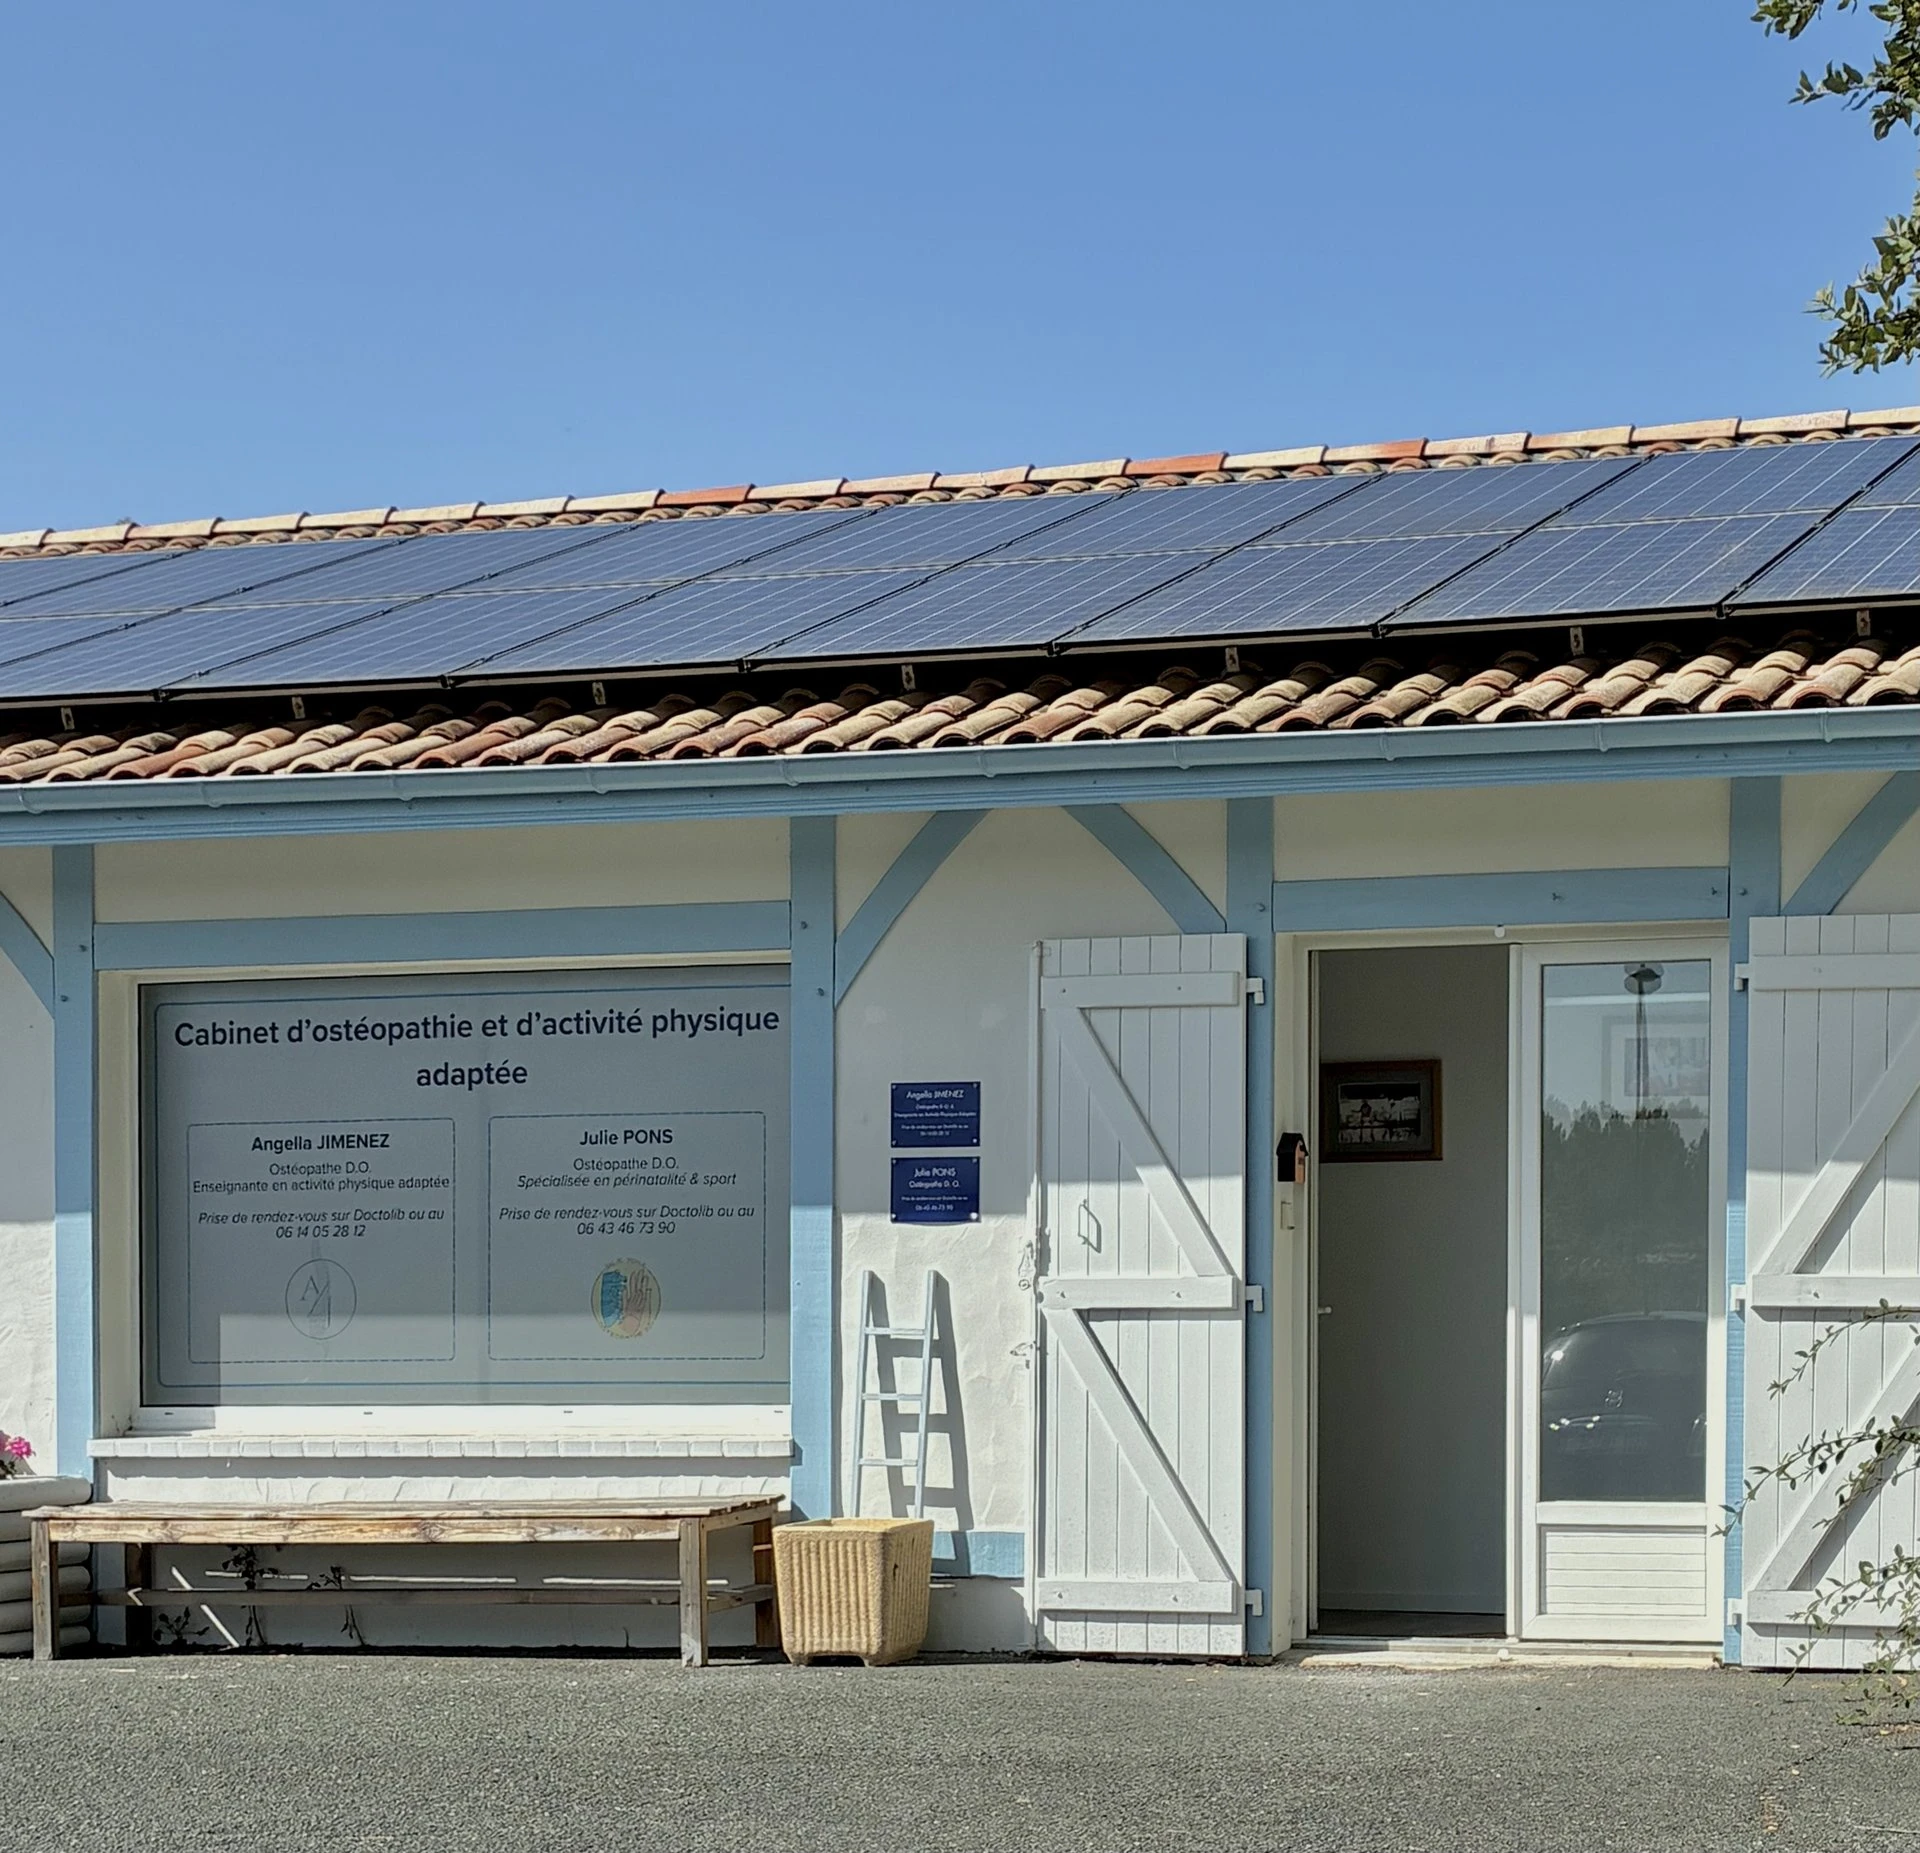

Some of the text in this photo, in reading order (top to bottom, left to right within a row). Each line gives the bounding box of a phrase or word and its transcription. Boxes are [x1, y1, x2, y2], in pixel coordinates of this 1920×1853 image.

[175, 1006, 779, 1046] Cabinet d’ostéopathie et d’activité physique
[416, 1059, 528, 1091] adaptée
[251, 1134, 390, 1154] Angella JIMENEZ
[579, 1129, 673, 1146] Julie PONS
[269, 1161, 372, 1177] Ostéopathe D.O.
[573, 1156, 679, 1172] Ostéopathe D.O.
[193, 1175, 450, 1195] Enseignante en activité physique adaptée
[517, 1172, 737, 1189] Spécialisée en périnatalité & sport
[198, 1208, 445, 1224] Prise de rendez-vous sur Doctolib ou au
[499, 1204, 755, 1220] Prise de rendez-vous sur Doctolib ou au
[276, 1224, 366, 1238] 06 14 05 28 12
[577, 1221, 676, 1235] 06 43 46 73 90
